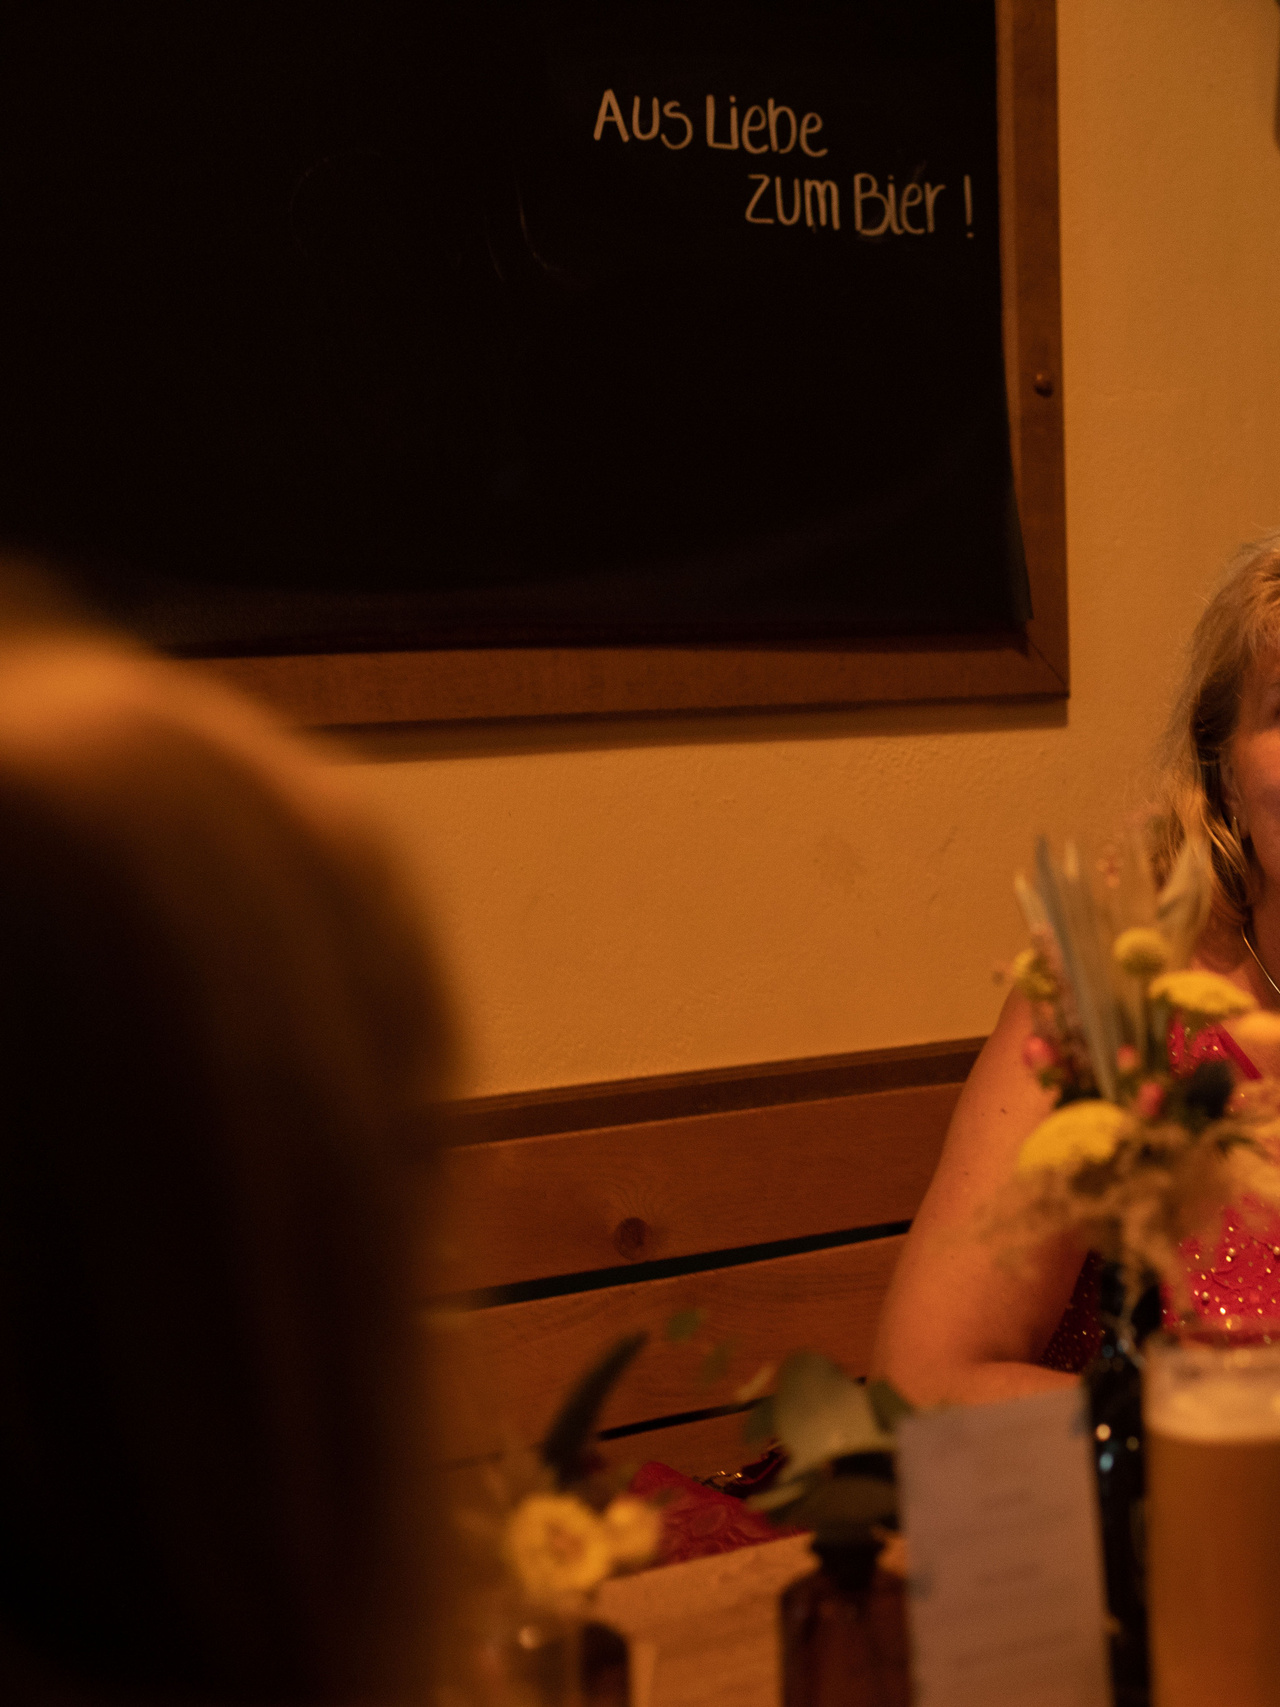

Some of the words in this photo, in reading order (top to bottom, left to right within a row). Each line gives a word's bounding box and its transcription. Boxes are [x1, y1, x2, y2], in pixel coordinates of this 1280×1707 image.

[594, 88, 694, 150] Aus
[706, 94, 829, 158] Liebe
[745, 174, 841, 231] zum
